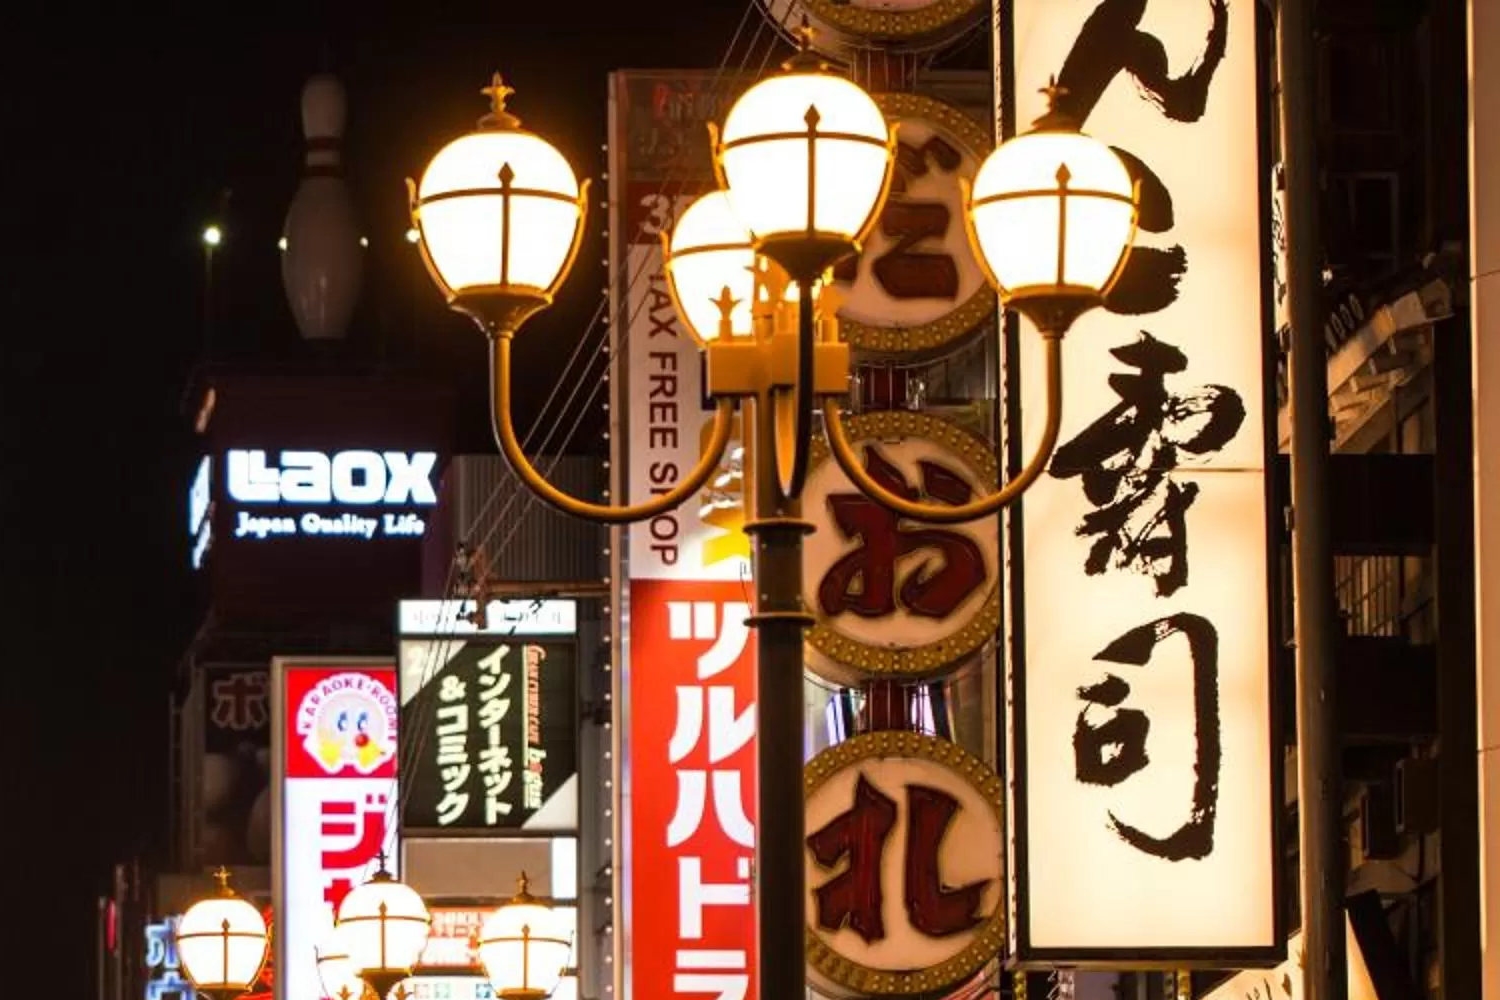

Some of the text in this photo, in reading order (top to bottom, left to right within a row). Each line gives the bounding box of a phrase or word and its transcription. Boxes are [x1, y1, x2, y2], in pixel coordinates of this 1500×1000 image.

[648, 351, 678, 450] FREE
[235, 512, 425, 540] Japan Quality Life
[648, 461, 679, 567] SHOP
[435, 674, 471, 826] &コミック
[476, 644, 513, 826] インターネット
